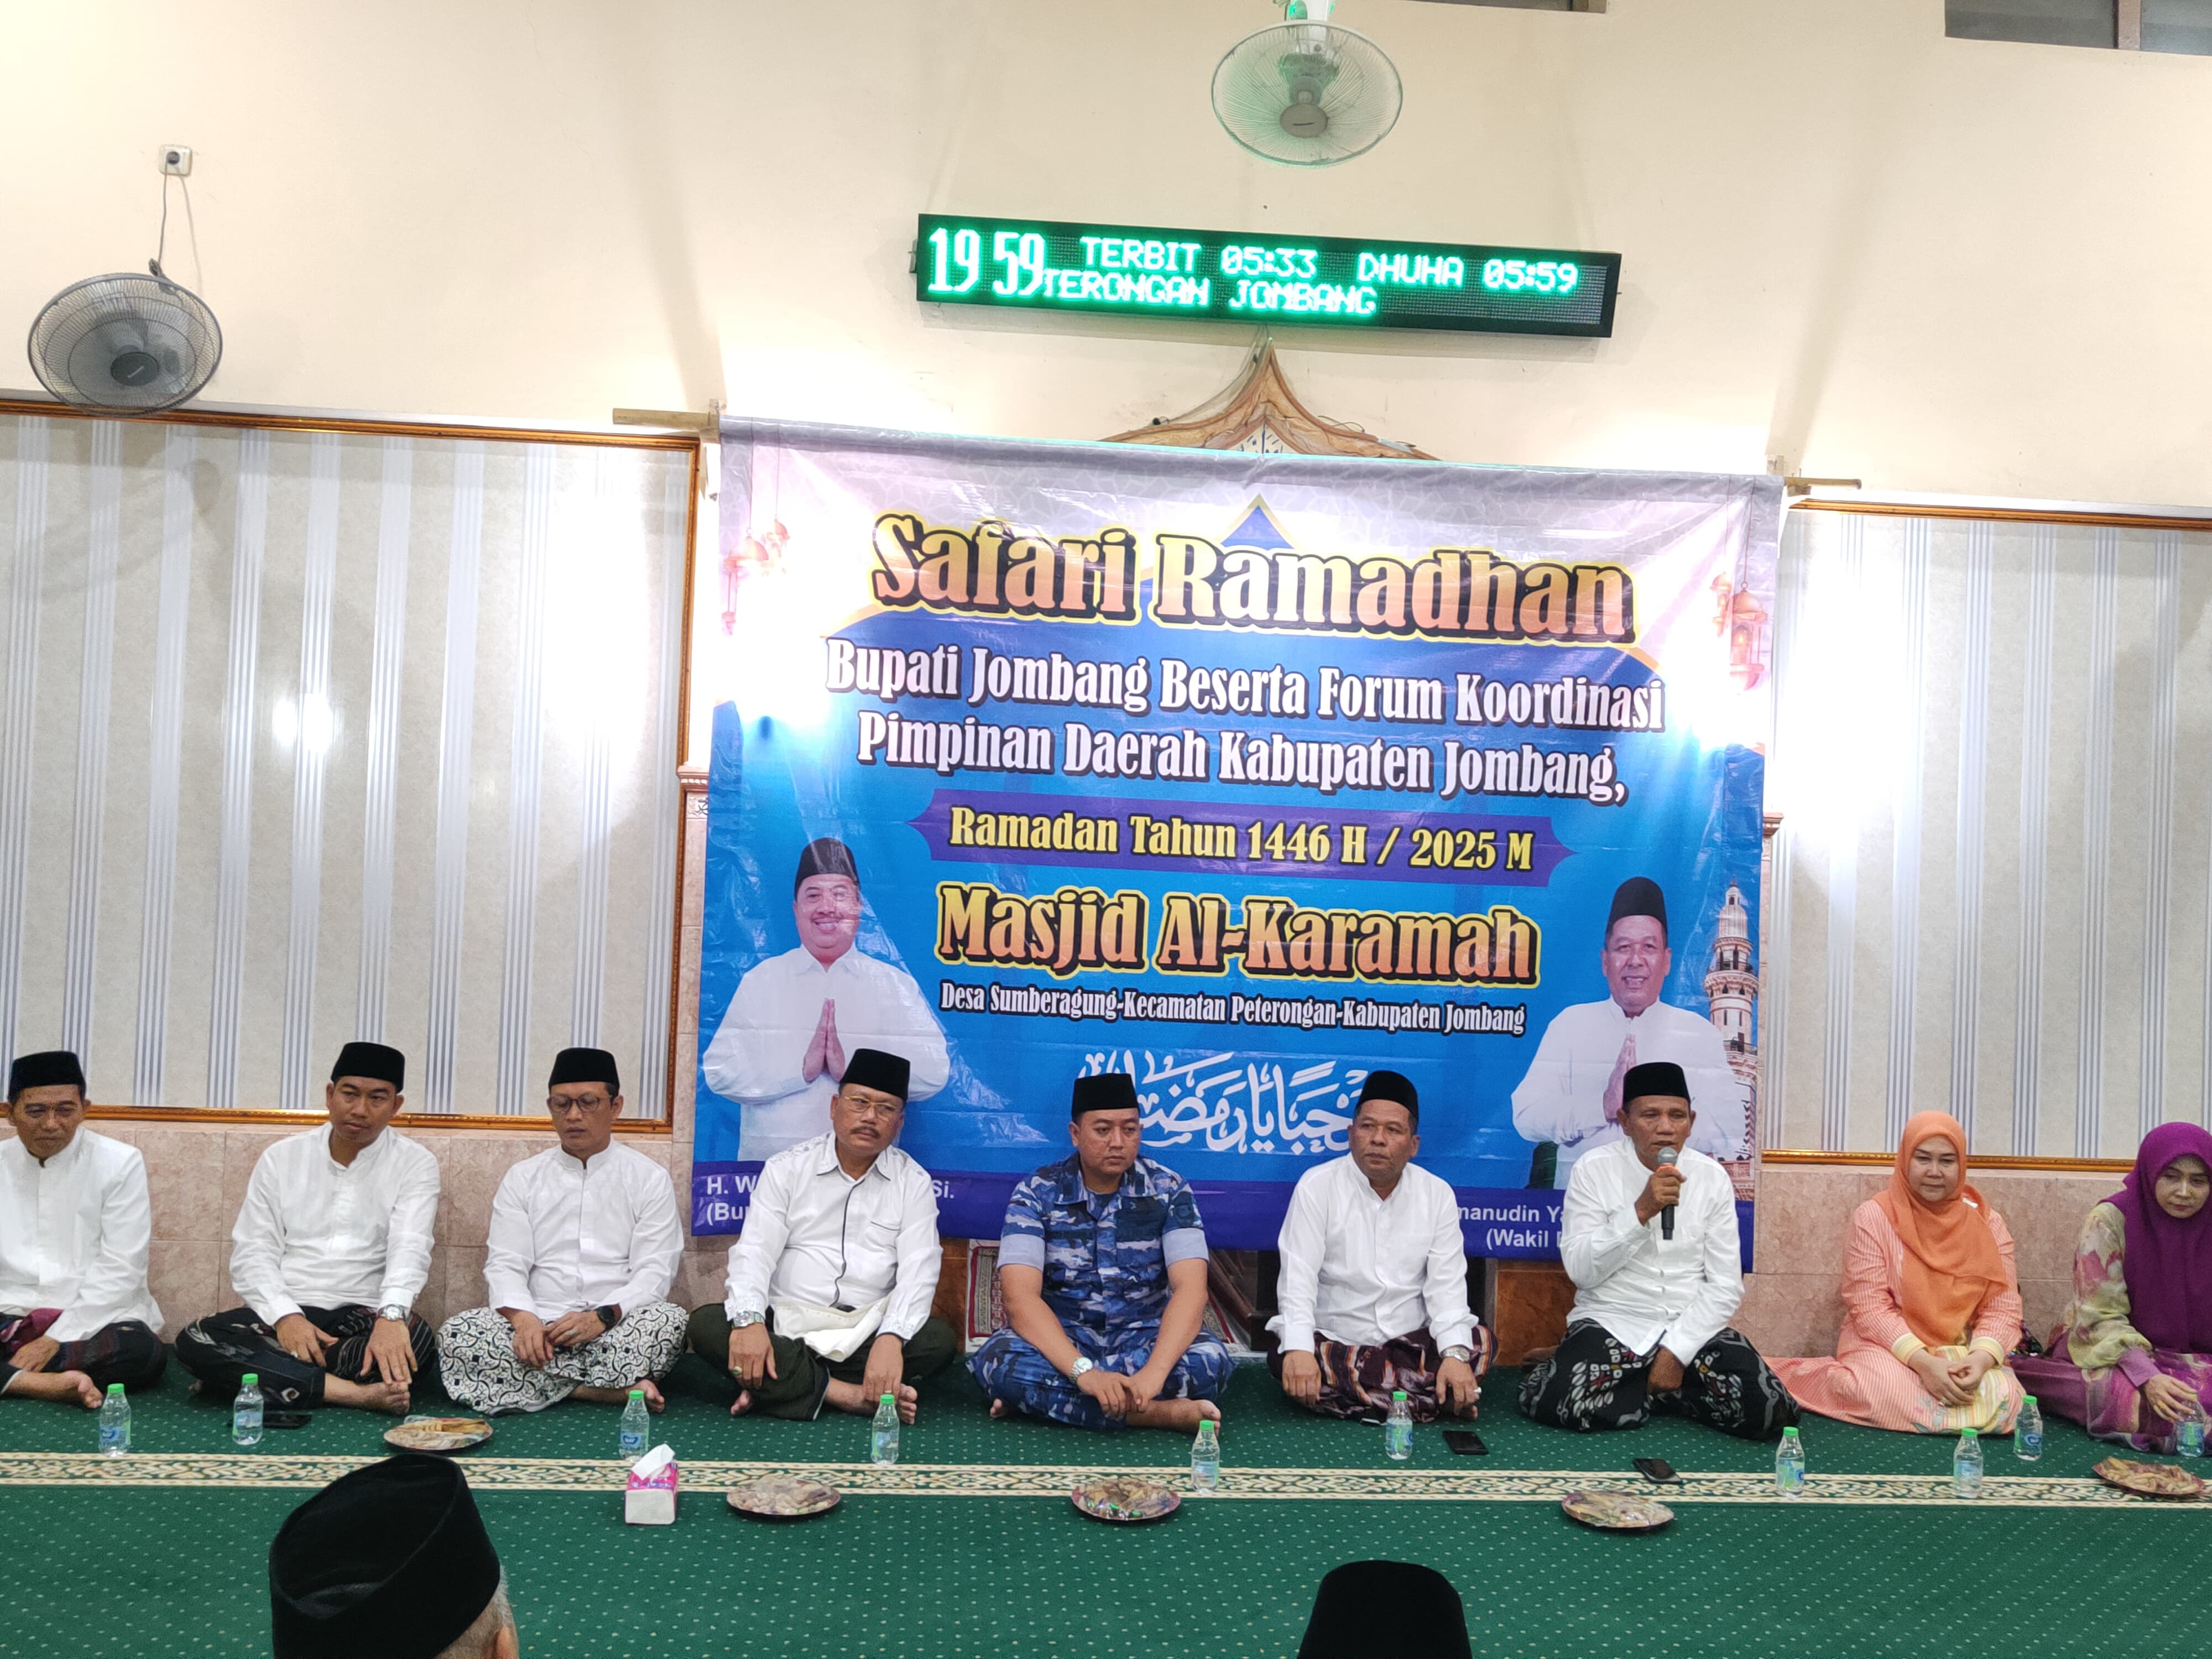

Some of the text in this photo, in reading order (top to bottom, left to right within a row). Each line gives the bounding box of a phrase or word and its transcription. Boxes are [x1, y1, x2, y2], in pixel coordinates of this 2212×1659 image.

[928, 227, 1047, 296] 19 59
[1080, 236, 1579, 293] TERBIT 05:33 DHUHA 05:59
[1228, 279, 1378, 315] JOMBANG
[872, 513, 1637, 645] Safari Ramadhan
[826, 638, 1666, 733] Bupati Jombang Beserta Forum Koordinasi
[857, 709, 1627, 806] Pimpinan Daerah Kabupaten Jombang,
[949, 806, 1535, 870] Ramadan Tahun 1446 H / 2025 M
[939, 884, 1540, 982] Masjid Al-Karamah
[940, 981, 1527, 1036] Desa Sumberagung-Kecamatan Peterongan-Kabupaten Jombang
[707, 1175, 729, 1195] H.
[1457, 1204, 1540, 1223] manudin
[1486, 1227, 1549, 1251] (Wakil
